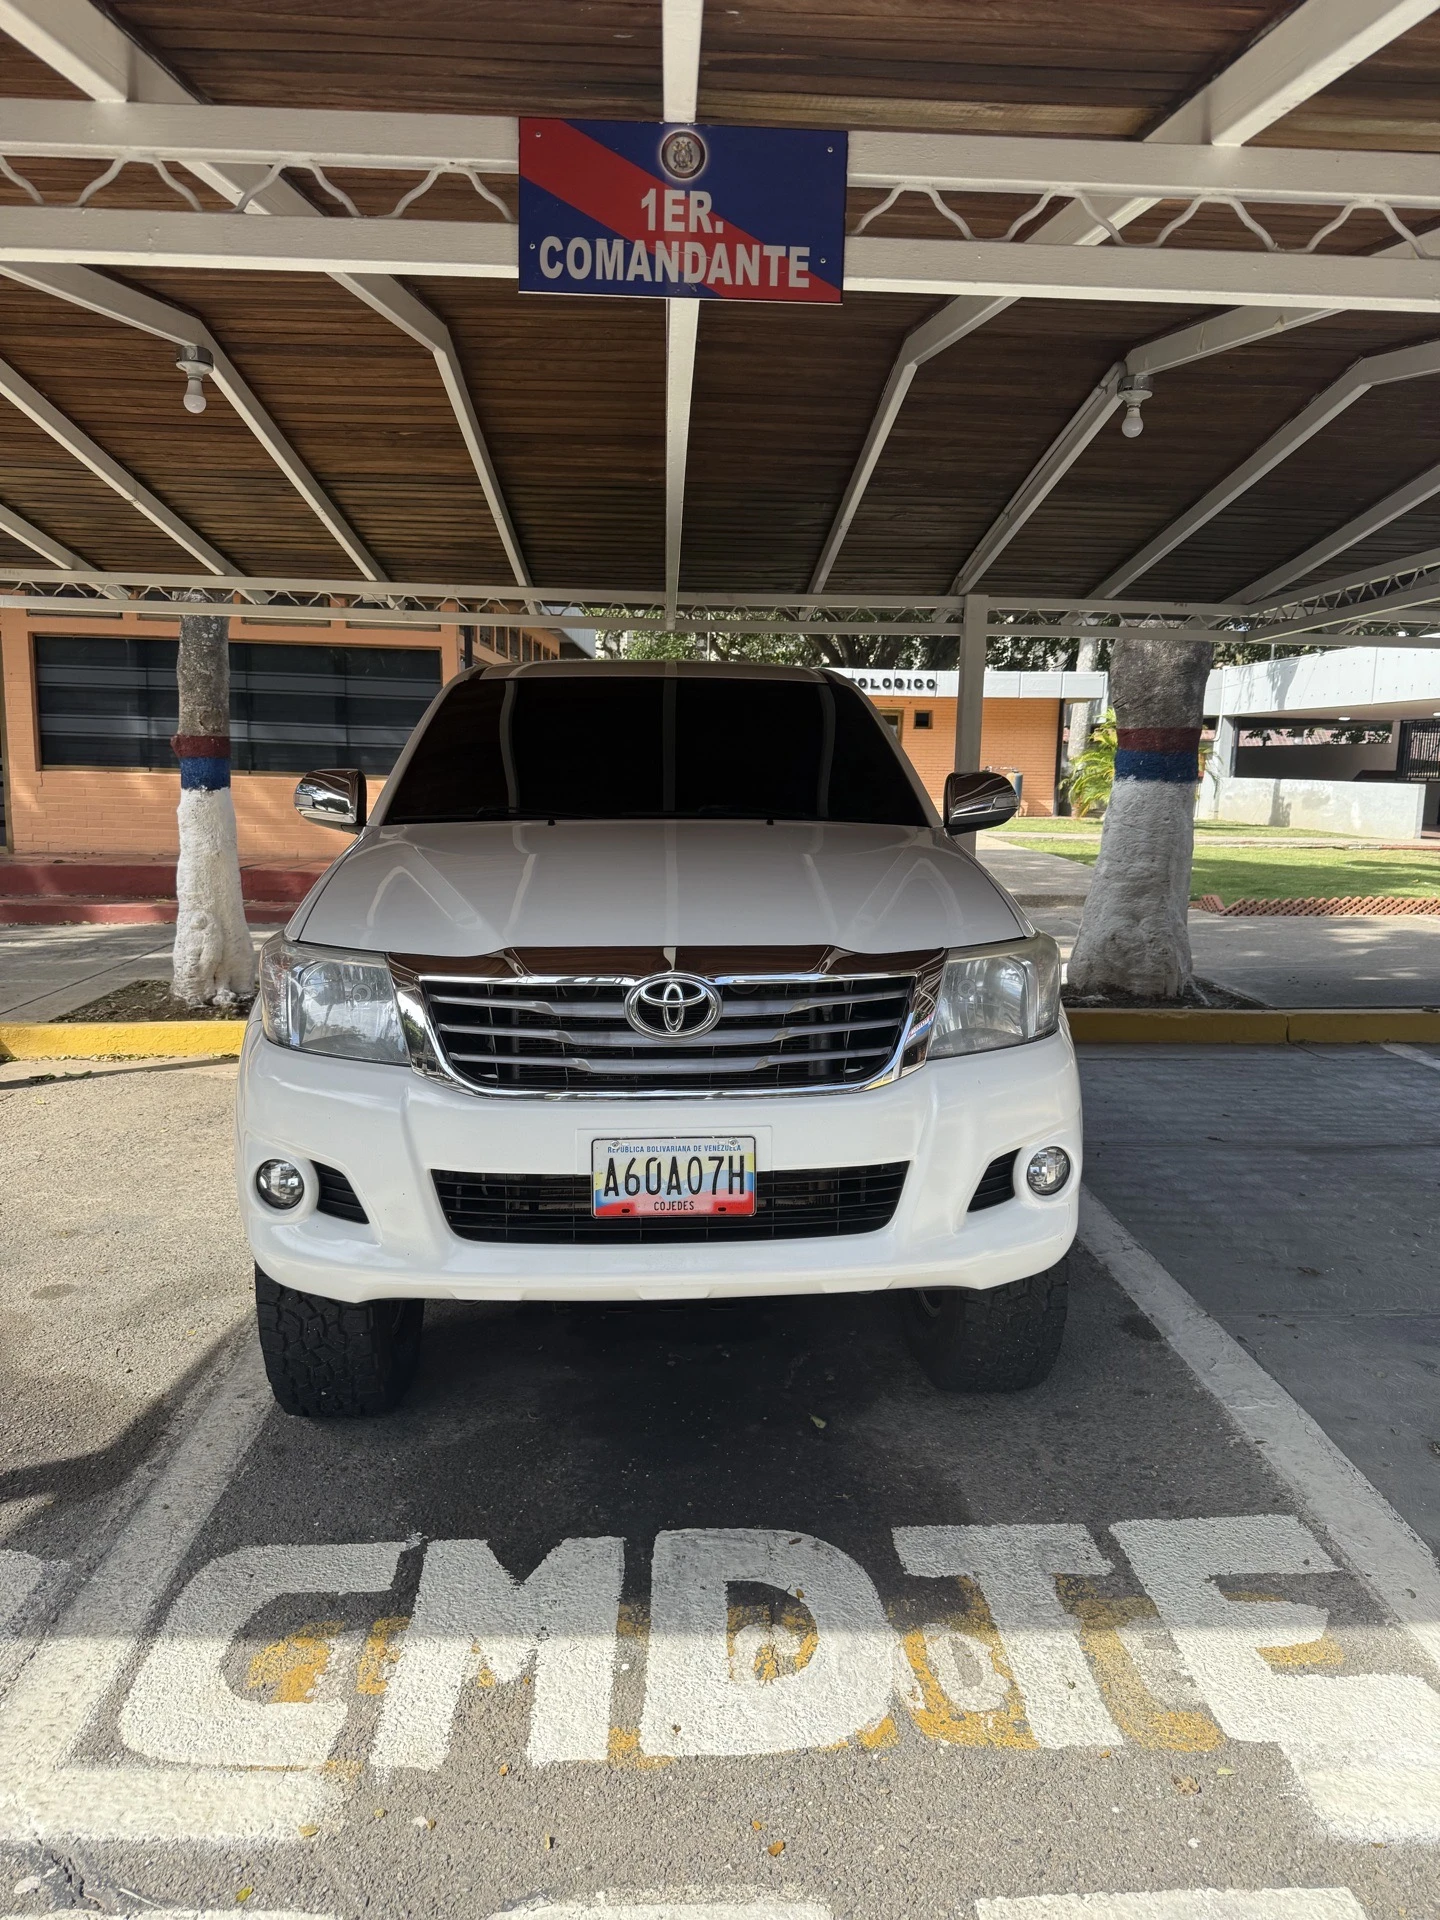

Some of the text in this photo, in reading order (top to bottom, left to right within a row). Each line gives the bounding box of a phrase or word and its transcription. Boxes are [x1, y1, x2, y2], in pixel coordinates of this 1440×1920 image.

[641, 188, 724, 234] 1ER.
[539, 235, 811, 288] COMANDANTE
[646, 1145, 691, 1154] BOLIVARIANA
[603, 1155, 745, 1197] A60A07H
[653, 1201, 695, 1211] COJEDES
